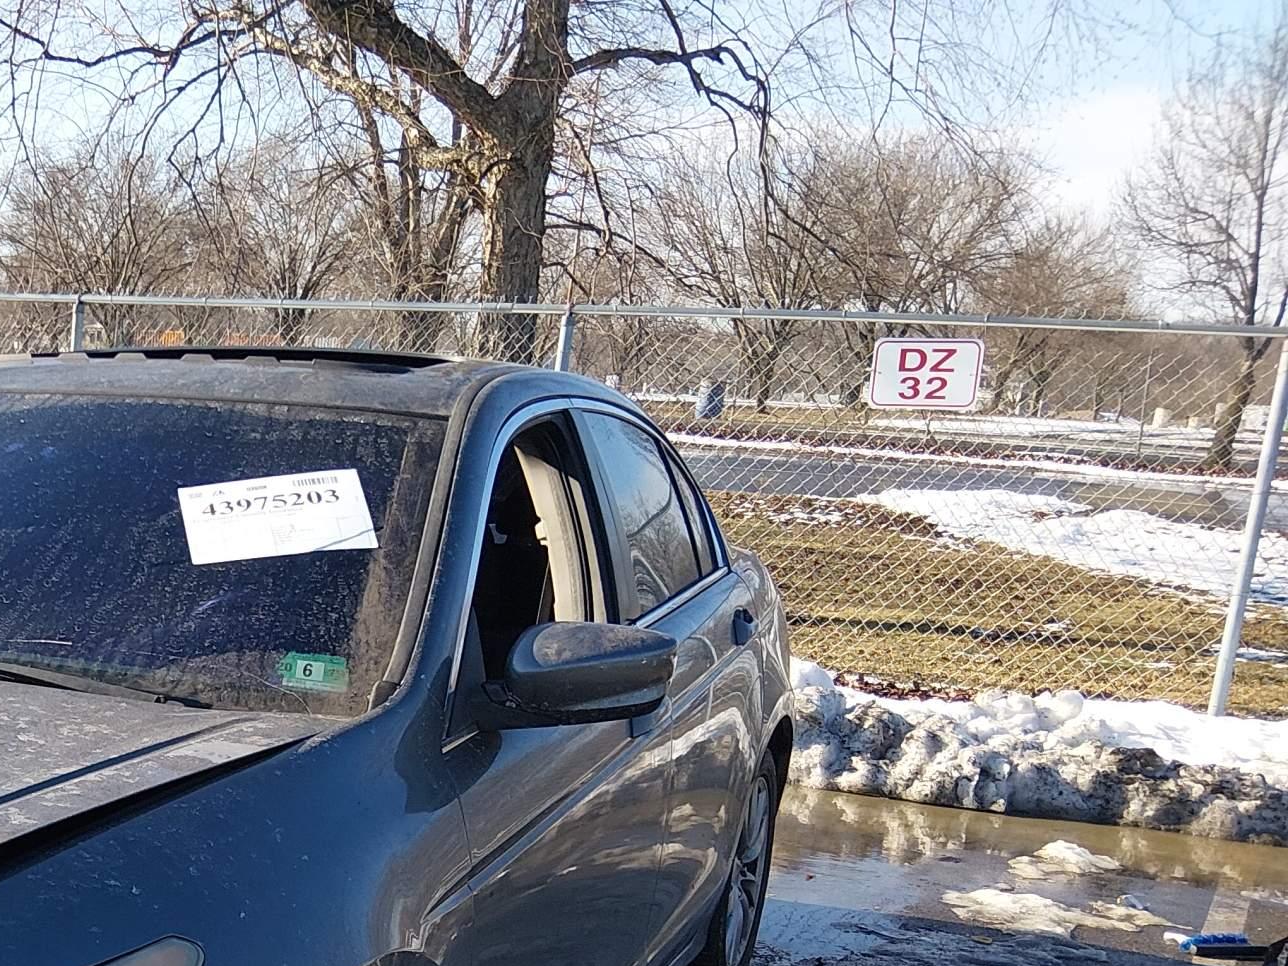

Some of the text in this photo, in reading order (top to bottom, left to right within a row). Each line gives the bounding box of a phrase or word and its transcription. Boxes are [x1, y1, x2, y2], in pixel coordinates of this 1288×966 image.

[898, 348, 957, 372] DZ
[897, 376, 948, 400] 32
[202, 489, 340, 516] 43975203
[302, 663, 314, 677] 6
